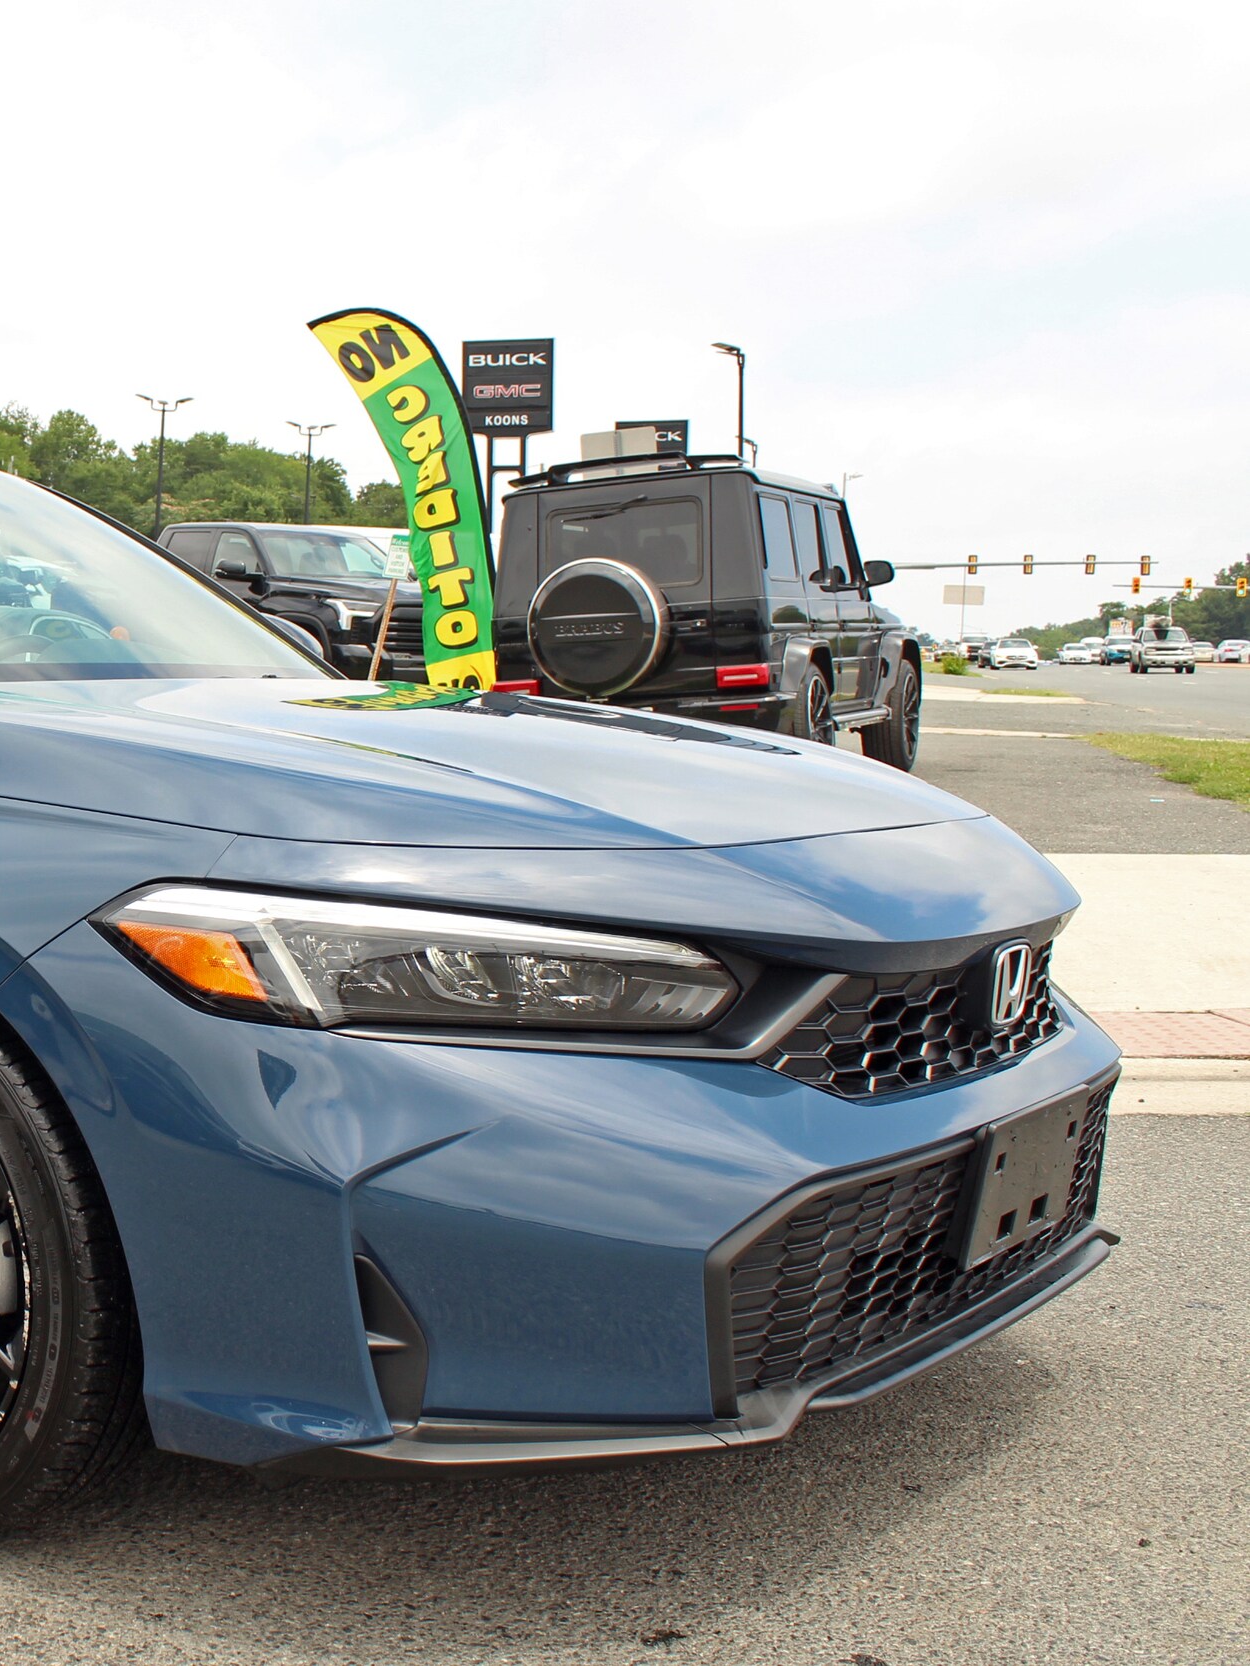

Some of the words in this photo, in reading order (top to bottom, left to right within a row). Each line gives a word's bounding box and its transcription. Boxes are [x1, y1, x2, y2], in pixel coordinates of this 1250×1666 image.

[468, 352, 546, 367] BUICK
[473, 383, 541, 398] GMC
[485, 413, 529, 426] KOONS
